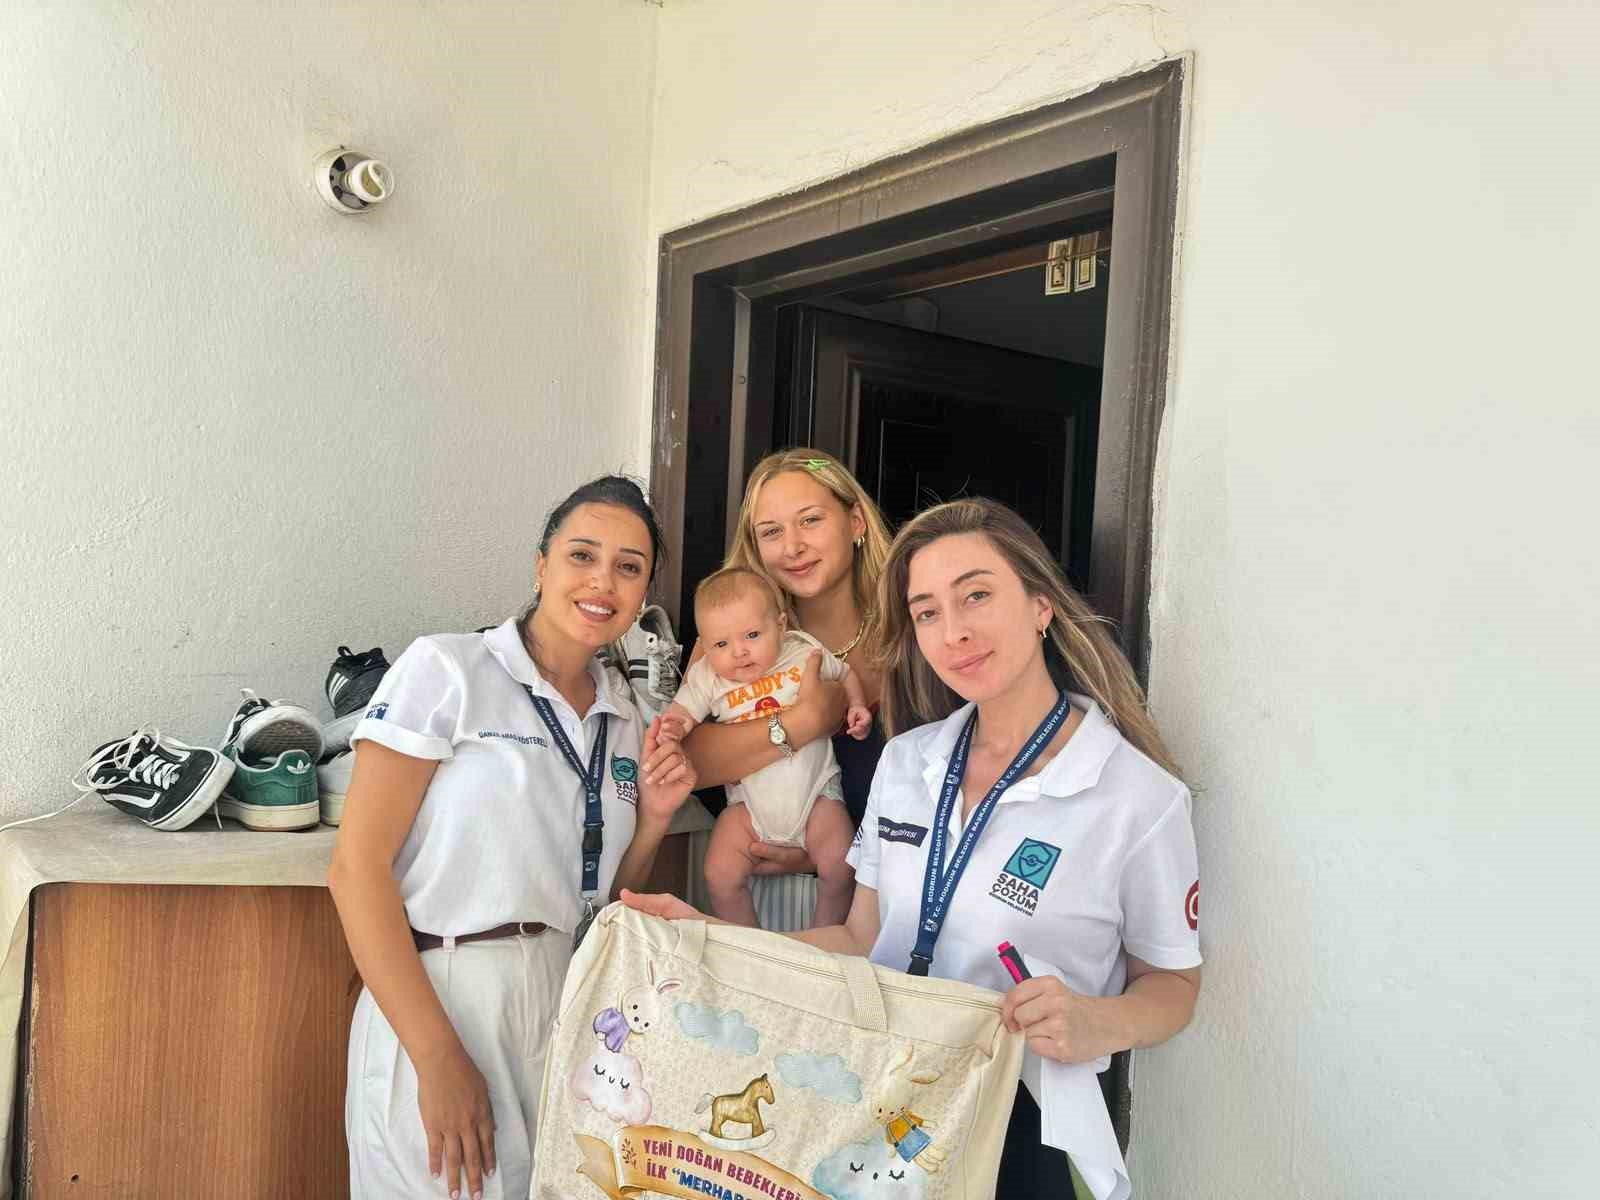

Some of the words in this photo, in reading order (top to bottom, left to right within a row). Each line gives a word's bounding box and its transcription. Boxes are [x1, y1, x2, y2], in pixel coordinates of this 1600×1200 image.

[727, 666, 801, 709] DADDY'S
[927, 871, 938, 903] BODRUM
[933, 904, 943, 918] T.C.
[940, 871, 956, 903] BODRUM
[955, 831, 975, 868] BELEDİYE
[997, 872, 1039, 902] SAHA
[643, 1139, 673, 1159] YENİ
[676, 1144, 724, 1174] DOĞAN
[646, 1158, 667, 1181] İLK
